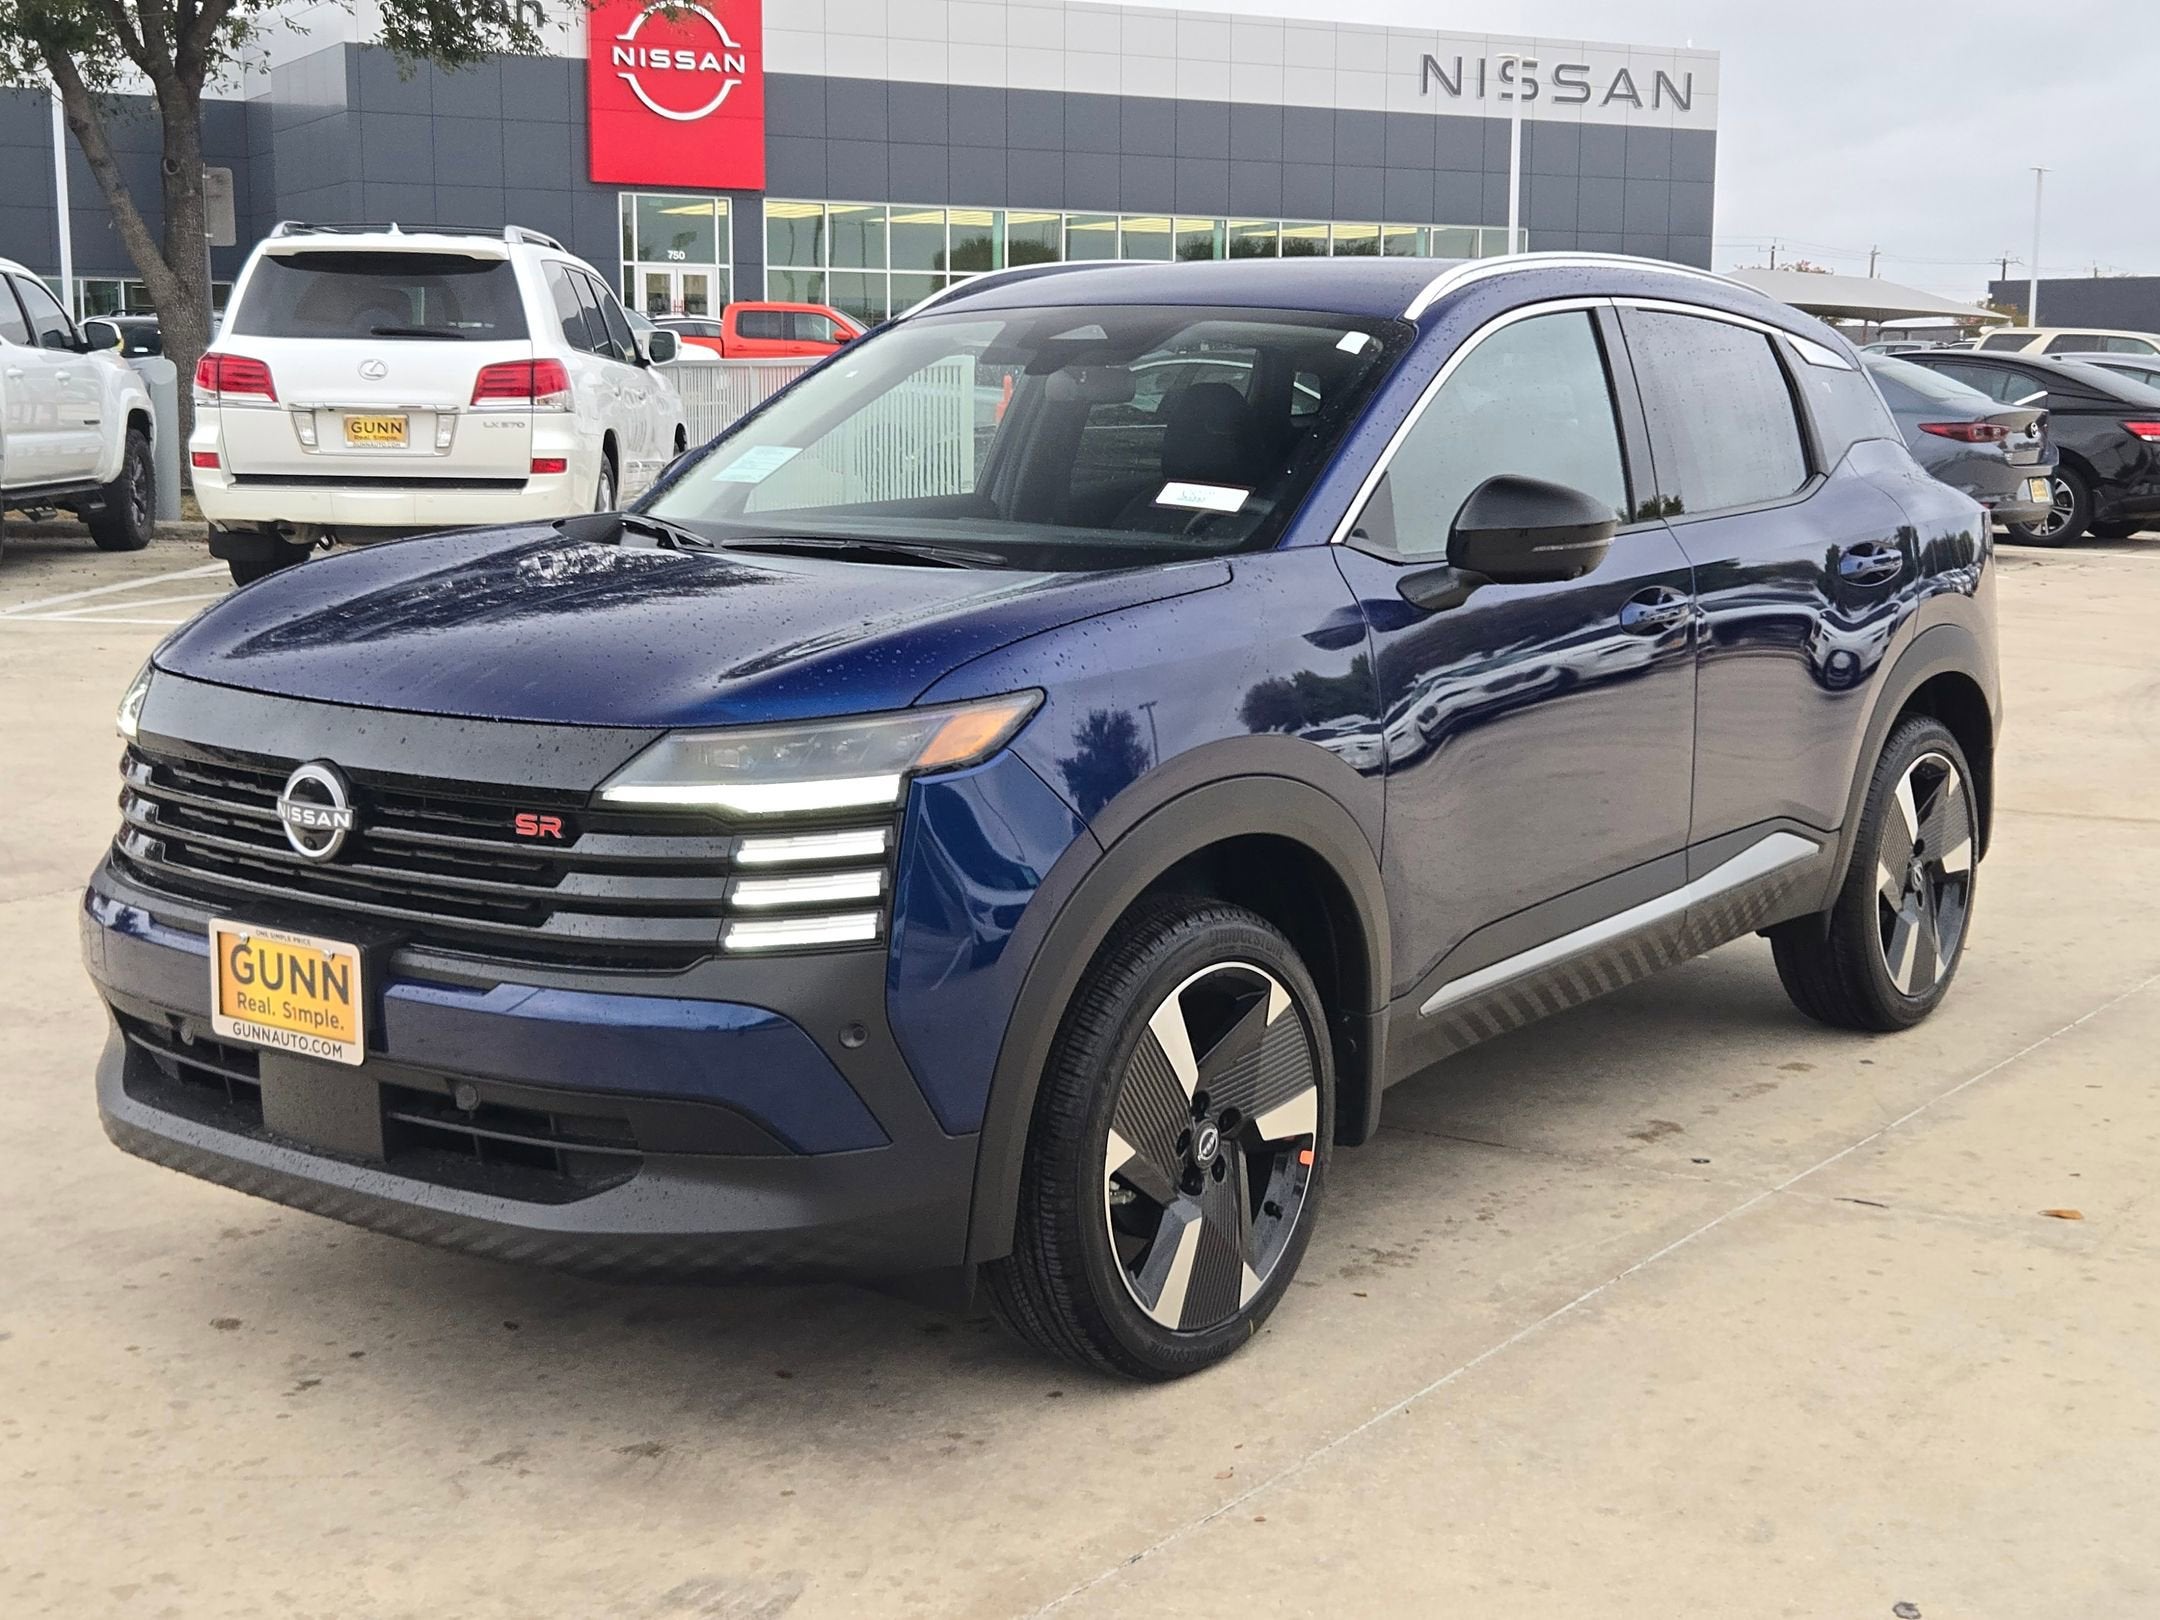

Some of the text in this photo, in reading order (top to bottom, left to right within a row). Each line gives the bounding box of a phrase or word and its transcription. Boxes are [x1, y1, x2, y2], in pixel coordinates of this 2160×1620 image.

[612, 46, 745, 73] NISSAN
[1420, 53, 1692, 111] NISSAN
[667, 250, 686, 260] 750
[351, 421, 402, 434] GUNN
[278, 801, 350, 828] NISSAN
[514, 813, 563, 839] SR
[255, 929, 312, 946] ONE SIMPLE PRICE
[230, 943, 350, 1005] GUNN
[237, 991, 276, 1016] Real.
[232, 1021, 344, 1059] GUNNAUTO.COM
